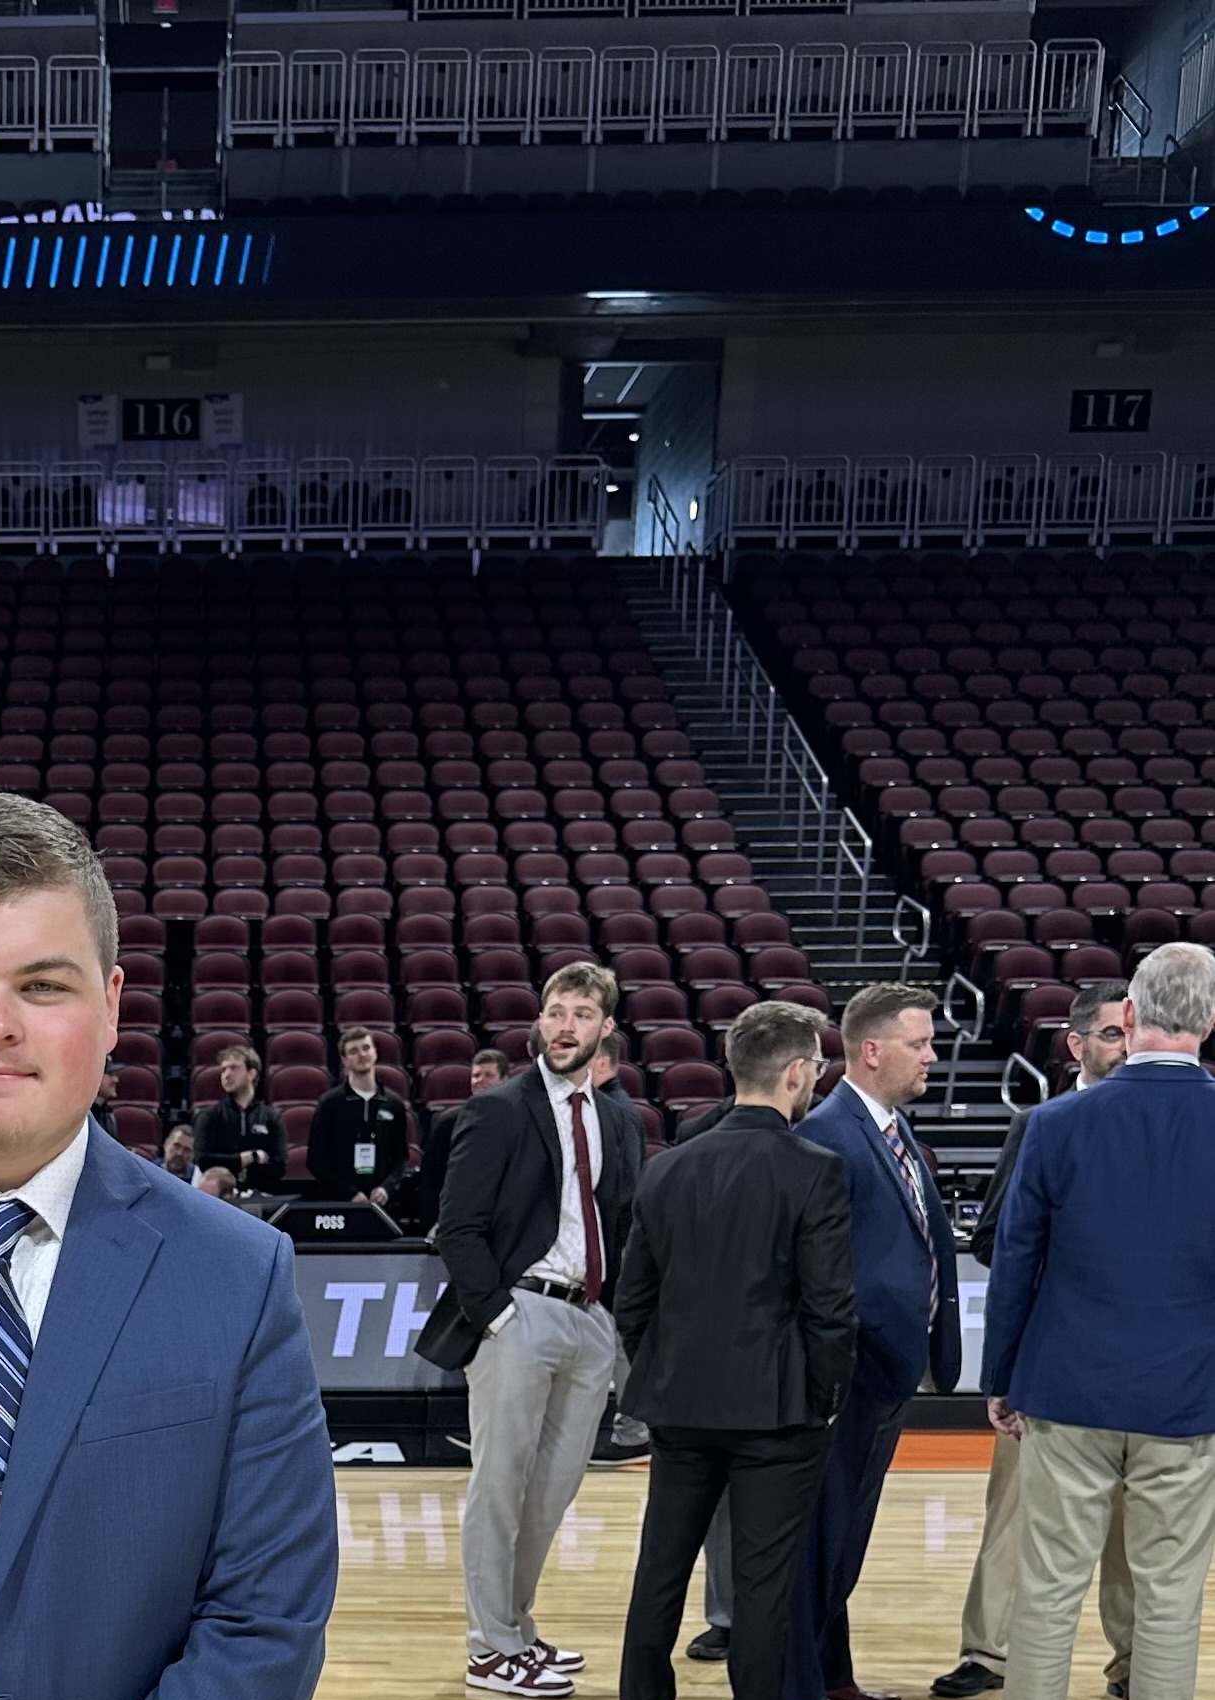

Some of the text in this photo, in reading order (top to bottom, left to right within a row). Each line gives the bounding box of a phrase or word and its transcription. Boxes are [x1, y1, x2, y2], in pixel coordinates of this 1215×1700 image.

[134, 403, 193, 436] 116
[1082, 393, 1145, 427] 117
[314, 1215, 346, 1230] POSS
